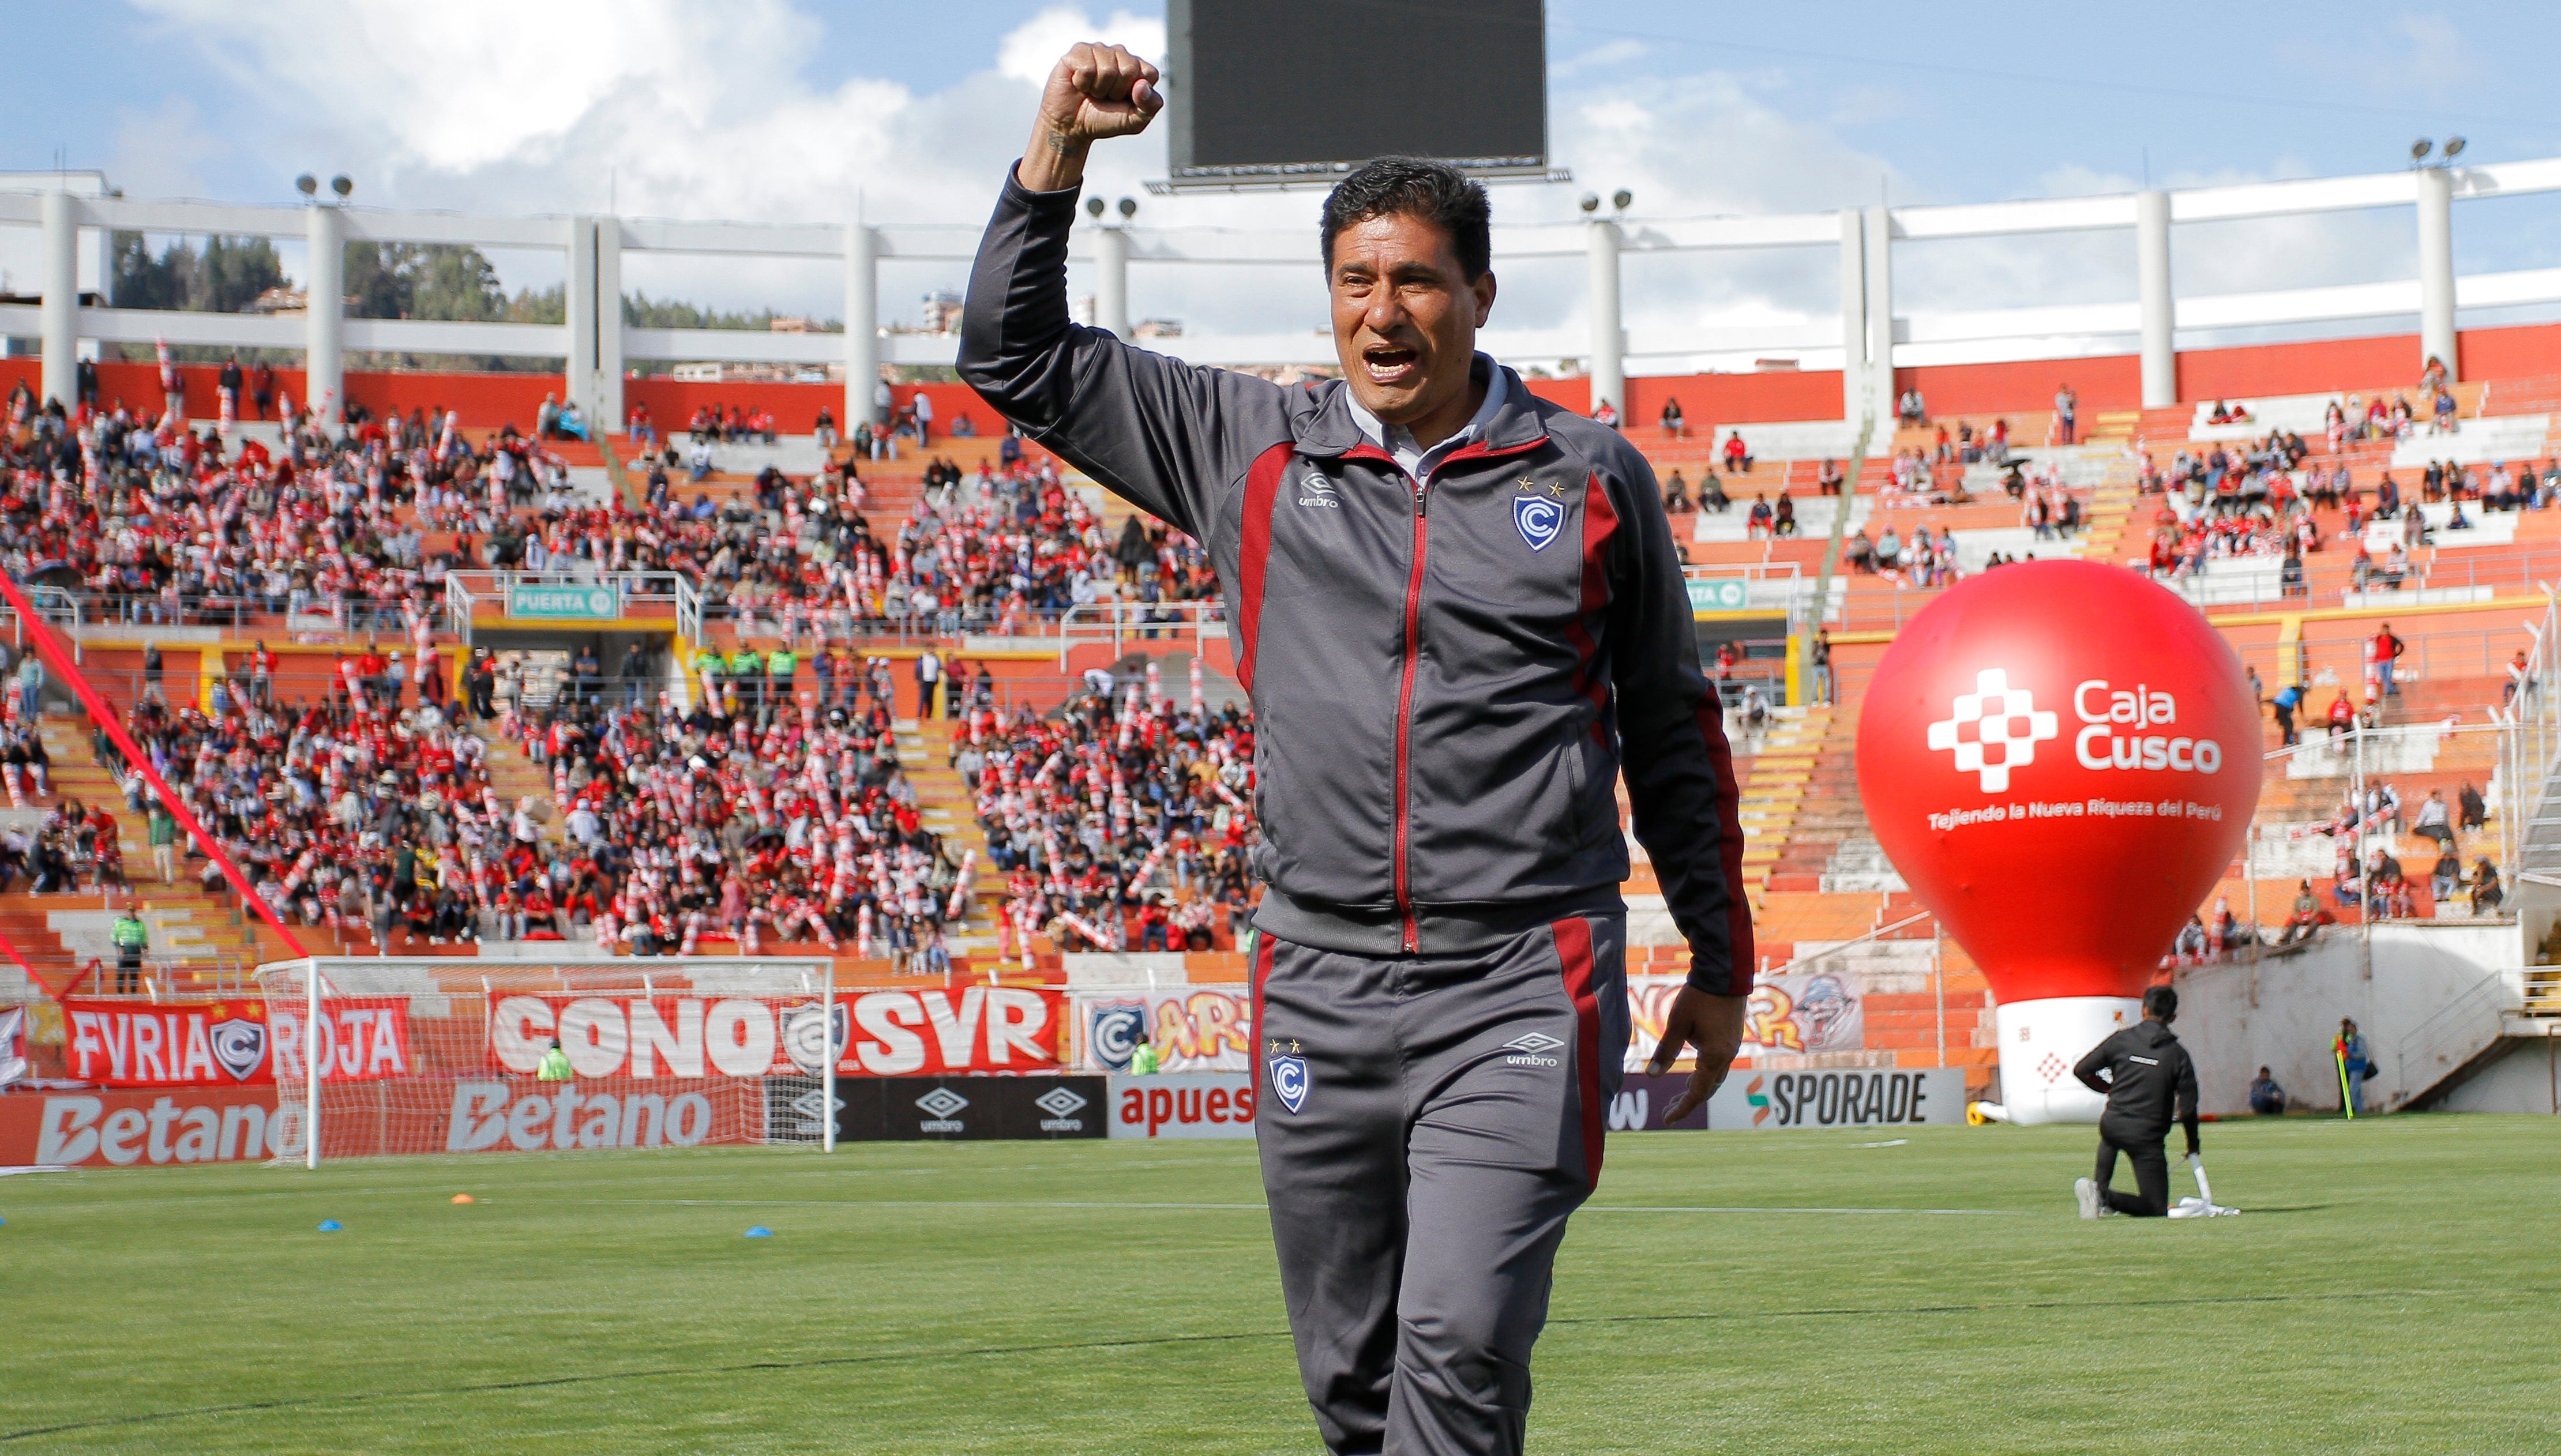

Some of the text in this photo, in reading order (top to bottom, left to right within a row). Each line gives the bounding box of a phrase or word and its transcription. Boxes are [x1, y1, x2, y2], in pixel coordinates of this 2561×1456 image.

[1298, 495, 1338, 507] umbro
[516, 592, 585, 610] PUERTA
[2075, 679, 2175, 729] Caja
[2075, 724, 2221, 774] Cusco
[1928, 798, 2222, 831] Tejiendo la Nueva Riqueza del Perú
[492, 996, 776, 1079] CONO
[1507, 1055, 1557, 1067] umbro
[447, 1083, 711, 1151] Betano
[1774, 1074, 1926, 1125] SPORADE
[36, 1097, 308, 1165] Betano
